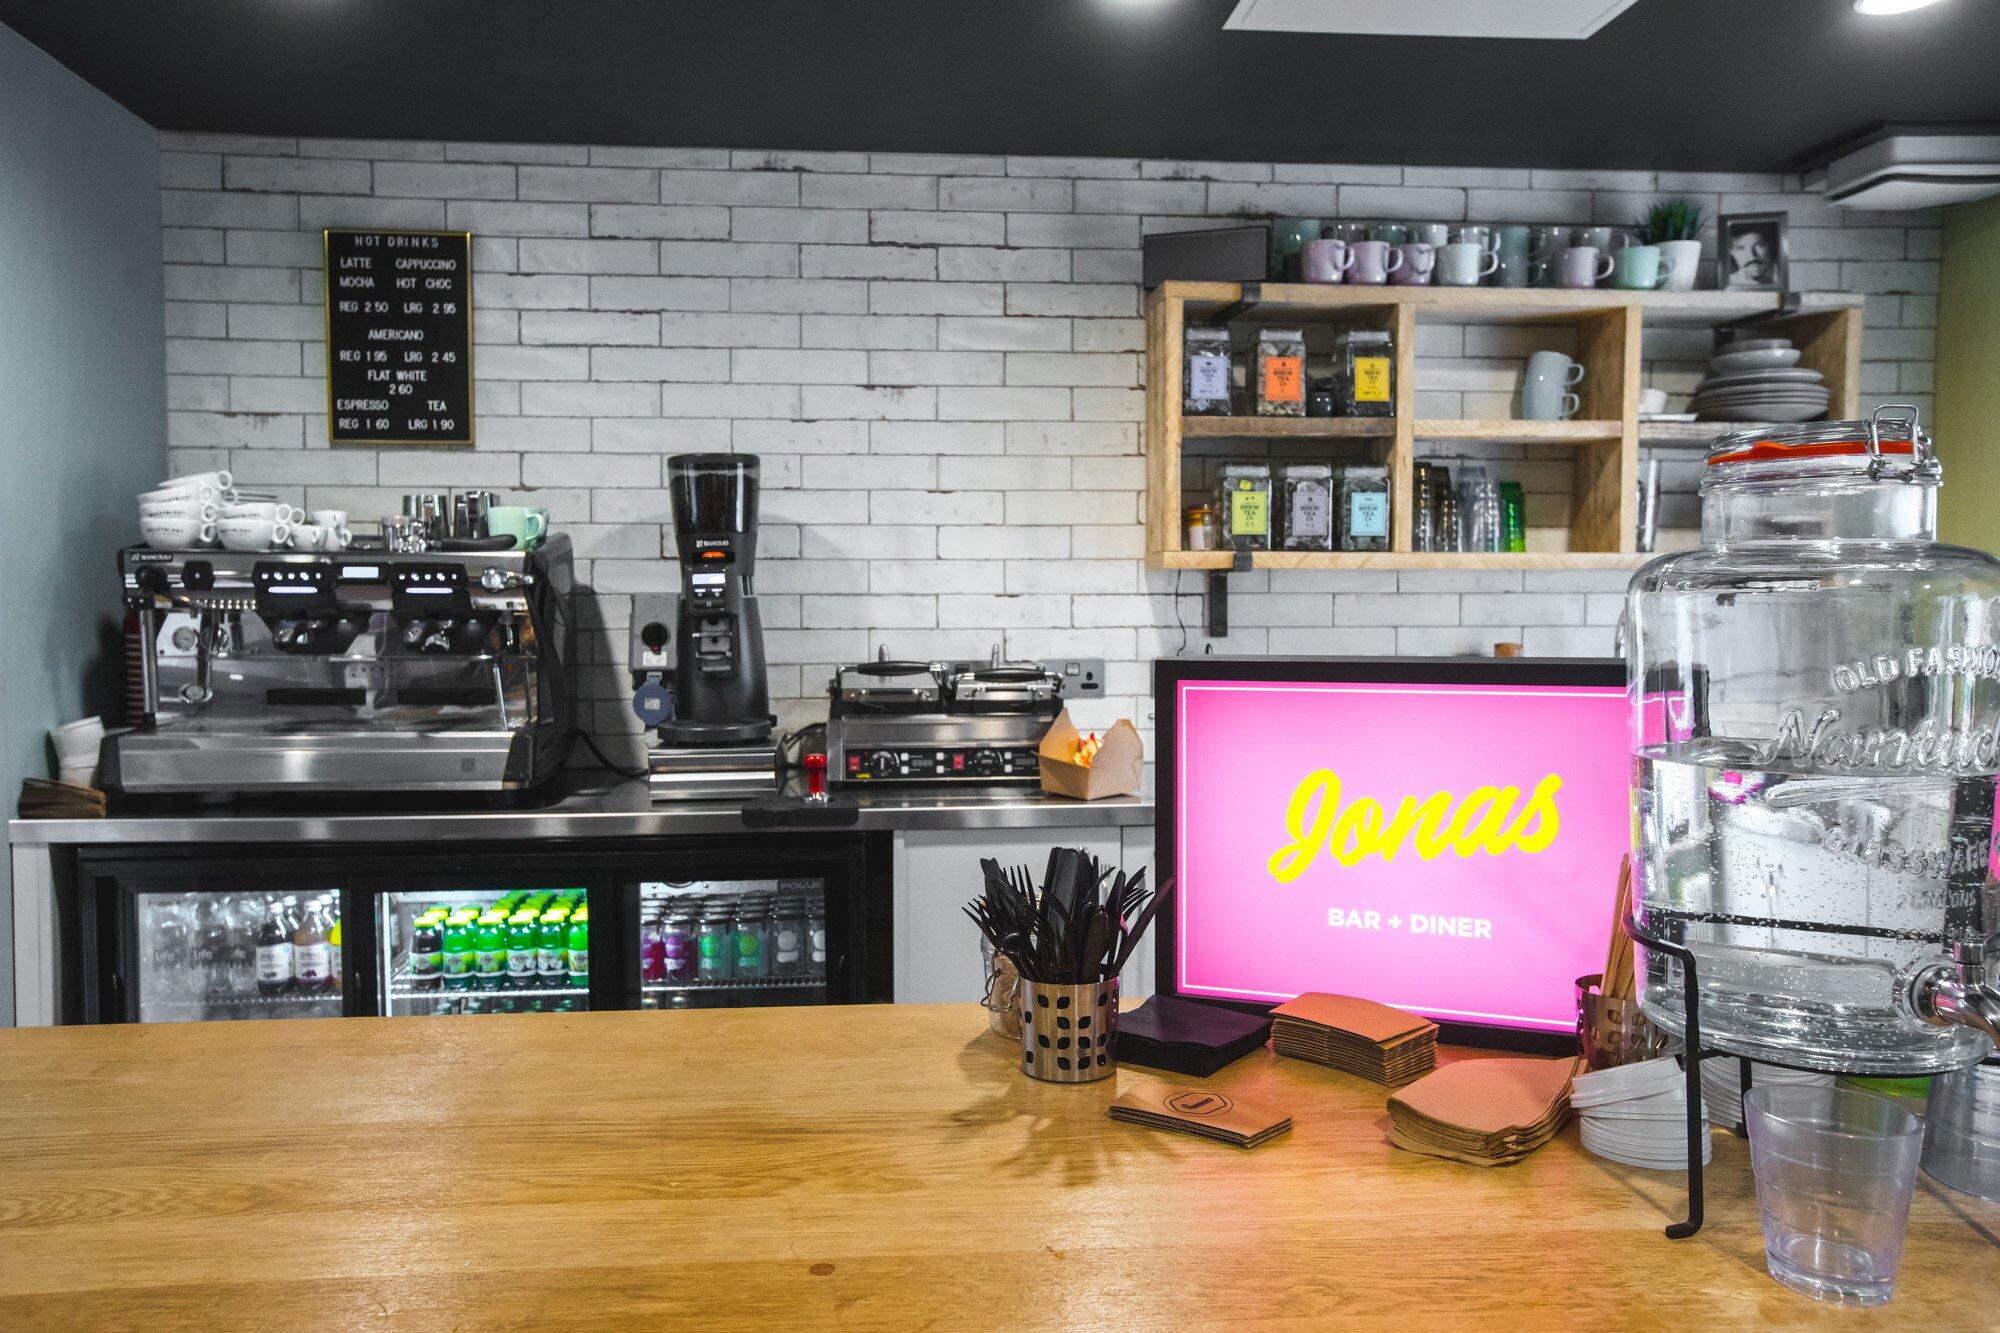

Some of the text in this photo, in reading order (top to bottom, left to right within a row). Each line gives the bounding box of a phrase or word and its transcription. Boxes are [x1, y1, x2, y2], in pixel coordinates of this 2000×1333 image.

[355, 237, 439, 248] HOT DRINKS
[340, 258, 372, 269] LATTE
[396, 259, 456, 270] CAPPUCCINO
[340, 277, 374, 288] MOCHA
[397, 278, 451, 289] HOT CHOC
[339, 301, 358, 312] REG
[404, 303, 423, 314] LRG
[368, 330, 424, 340] AMERICANO
[340, 351, 361, 361] REG
[405, 352, 423, 362] LRG
[368, 370, 427, 381] FLAT WHITE
[337, 400, 389, 410] ESPRESSO
[428, 401, 446, 411] TEA
[339, 419, 358, 429] REG
[409, 420, 427, 430] LRG
[1832, 644, 2000, 692] OLD FASHIO
[1752, 708, 2000, 770] Nantuc
[1268, 768, 1564, 884] Jonas
[1328, 907, 1381, 929] BAR
[1410, 914, 1492, 939] DINER
